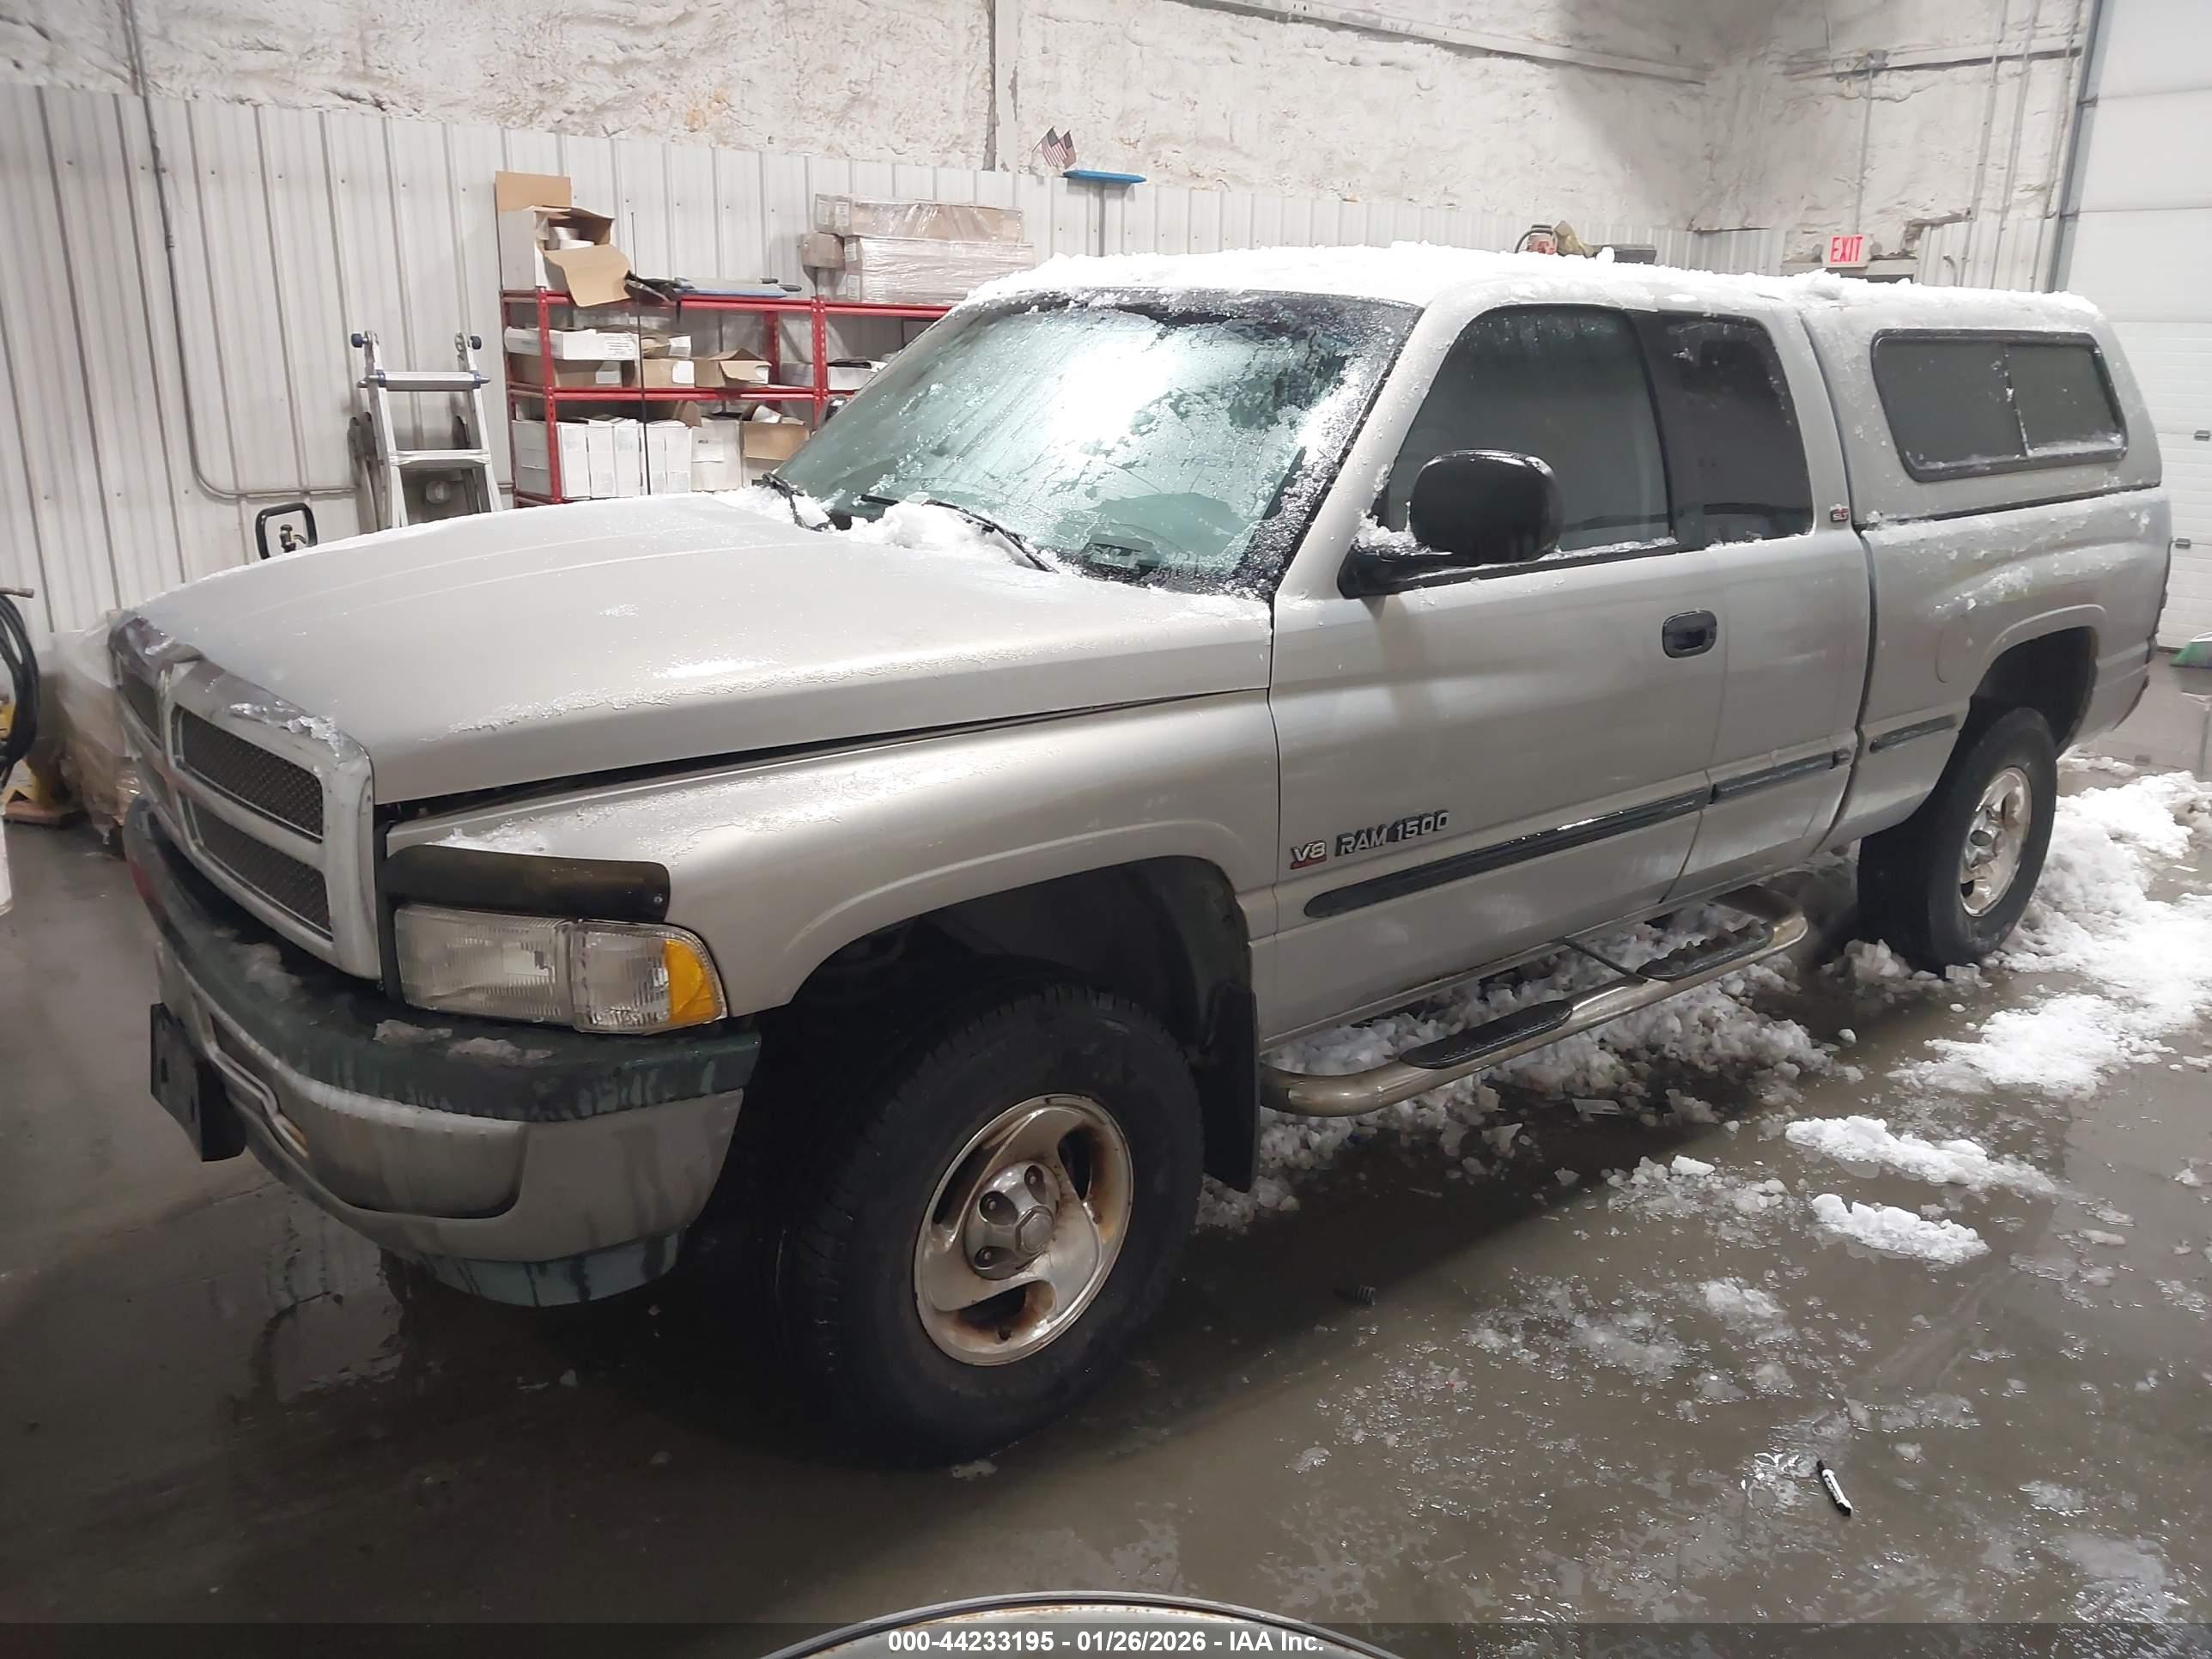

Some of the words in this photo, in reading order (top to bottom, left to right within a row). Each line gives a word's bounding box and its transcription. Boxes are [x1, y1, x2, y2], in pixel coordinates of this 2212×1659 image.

[1830, 235, 1863, 263] EXIT
[1338, 825, 1389, 856] RAM
[1395, 811, 1450, 842] 1500
[1292, 840, 1327, 864] V8
